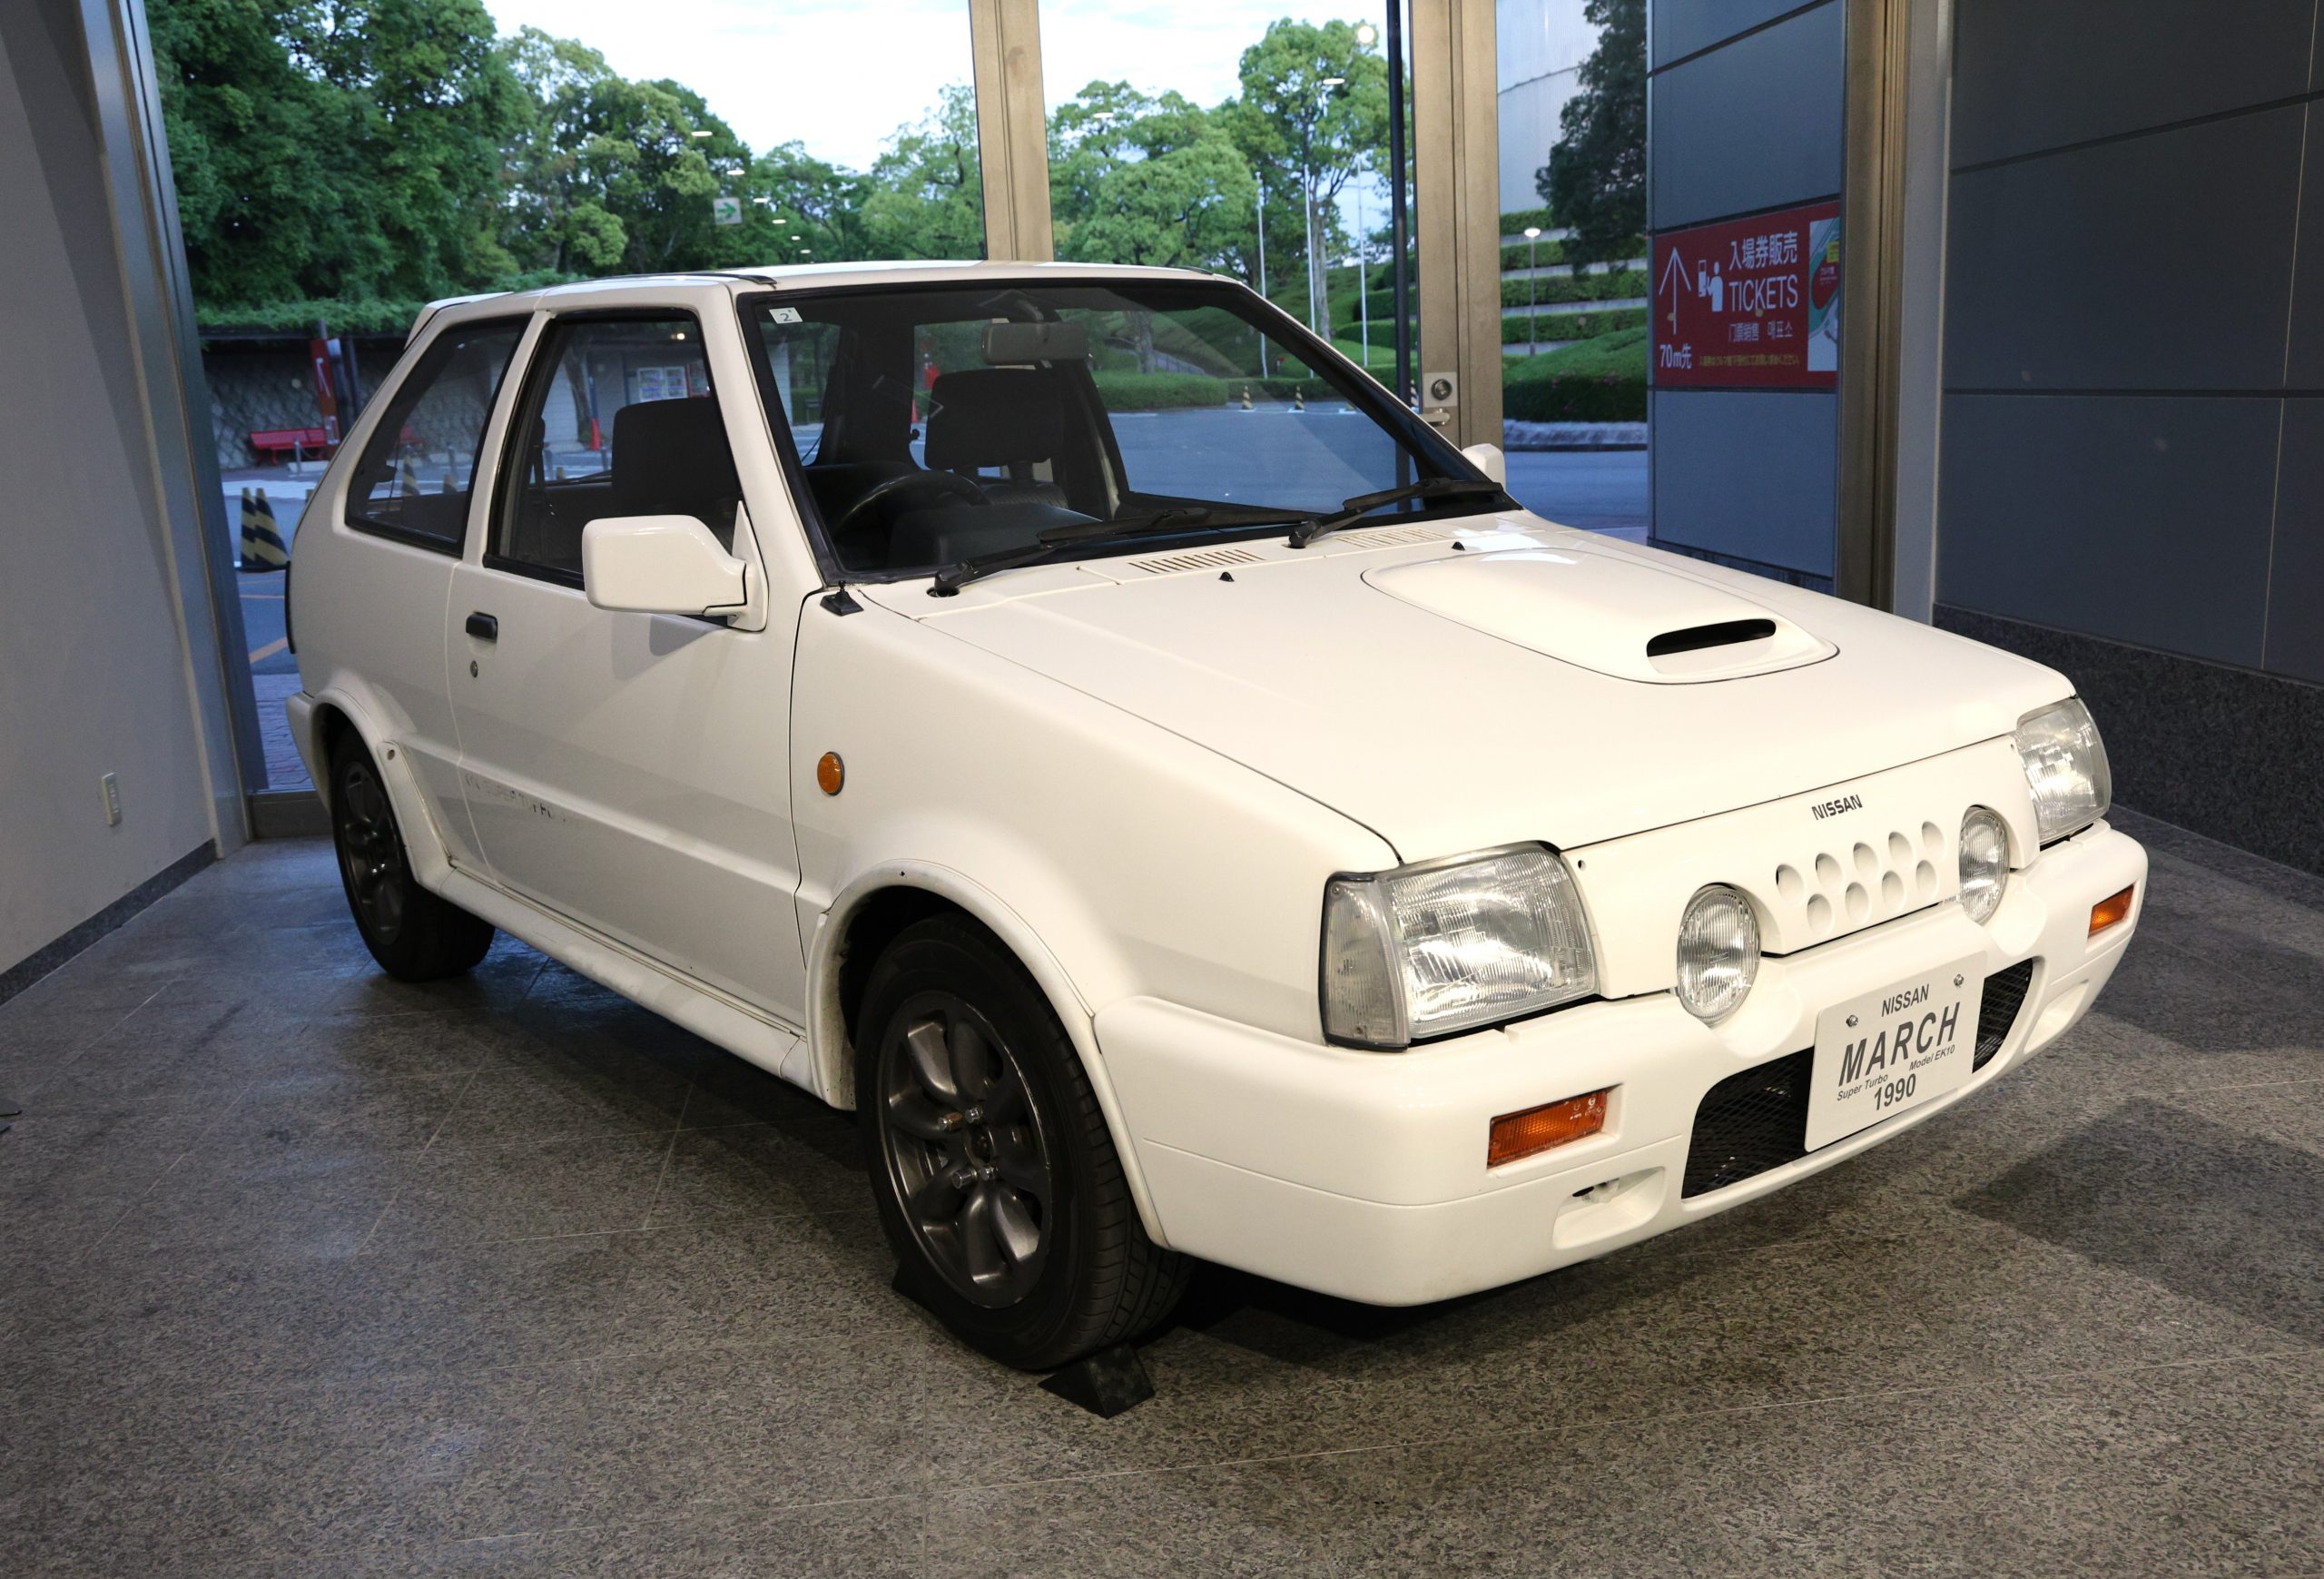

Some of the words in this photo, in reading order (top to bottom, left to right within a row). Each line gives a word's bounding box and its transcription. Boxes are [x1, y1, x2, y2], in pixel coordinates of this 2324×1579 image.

[1728, 231, 1798, 271] 入場券販売
[1728, 273, 1798, 312] TICKETS
[1659, 342, 1692, 370] 70m先
[1811, 794, 1864, 821] NISSAN
[1881, 983, 1930, 1018] NISSAN
[1837, 1001, 1961, 1088] MARCH
[1908, 1055, 1934, 1071] Model
[1934, 1044, 1955, 1061] EK10
[1837, 1084, 1862, 1101] Super
[1864, 1073, 1889, 1090] Turbo
[1874, 1072, 1916, 1111] 1990
